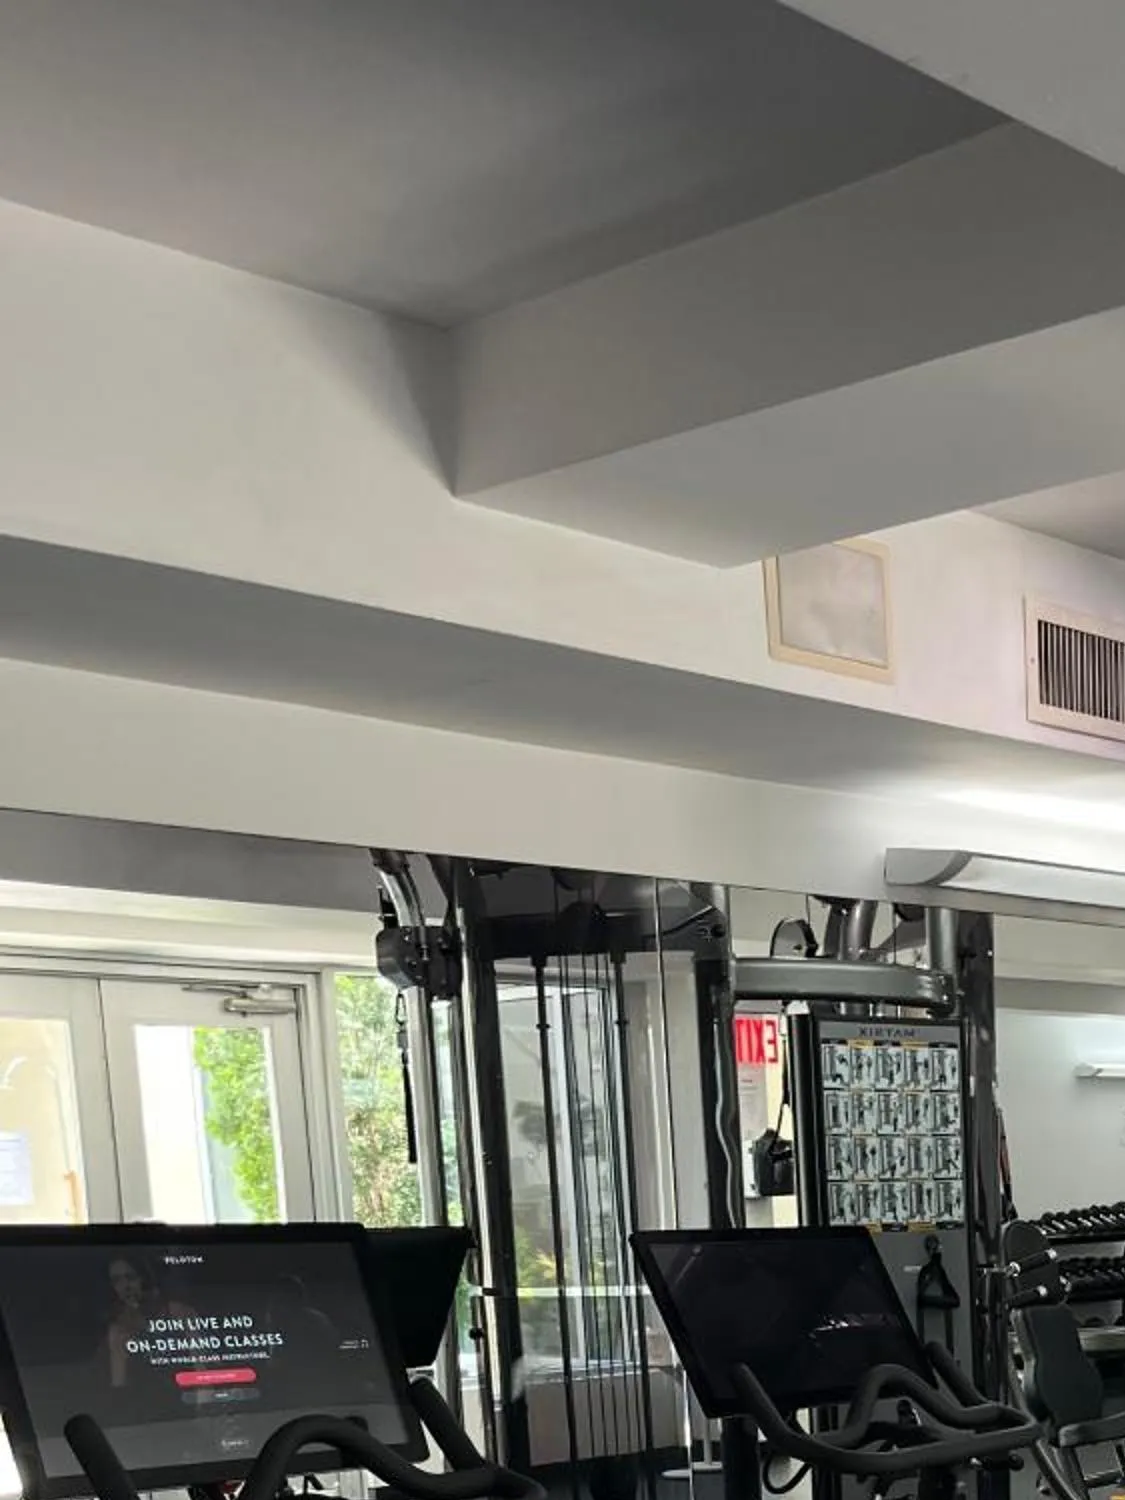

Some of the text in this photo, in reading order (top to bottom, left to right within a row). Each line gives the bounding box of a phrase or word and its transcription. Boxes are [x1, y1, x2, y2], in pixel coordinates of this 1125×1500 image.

[149, 1315, 253, 1333] JOIN LIVE AND
[126, 1333, 284, 1353] ON-DEMAND CLASSES
